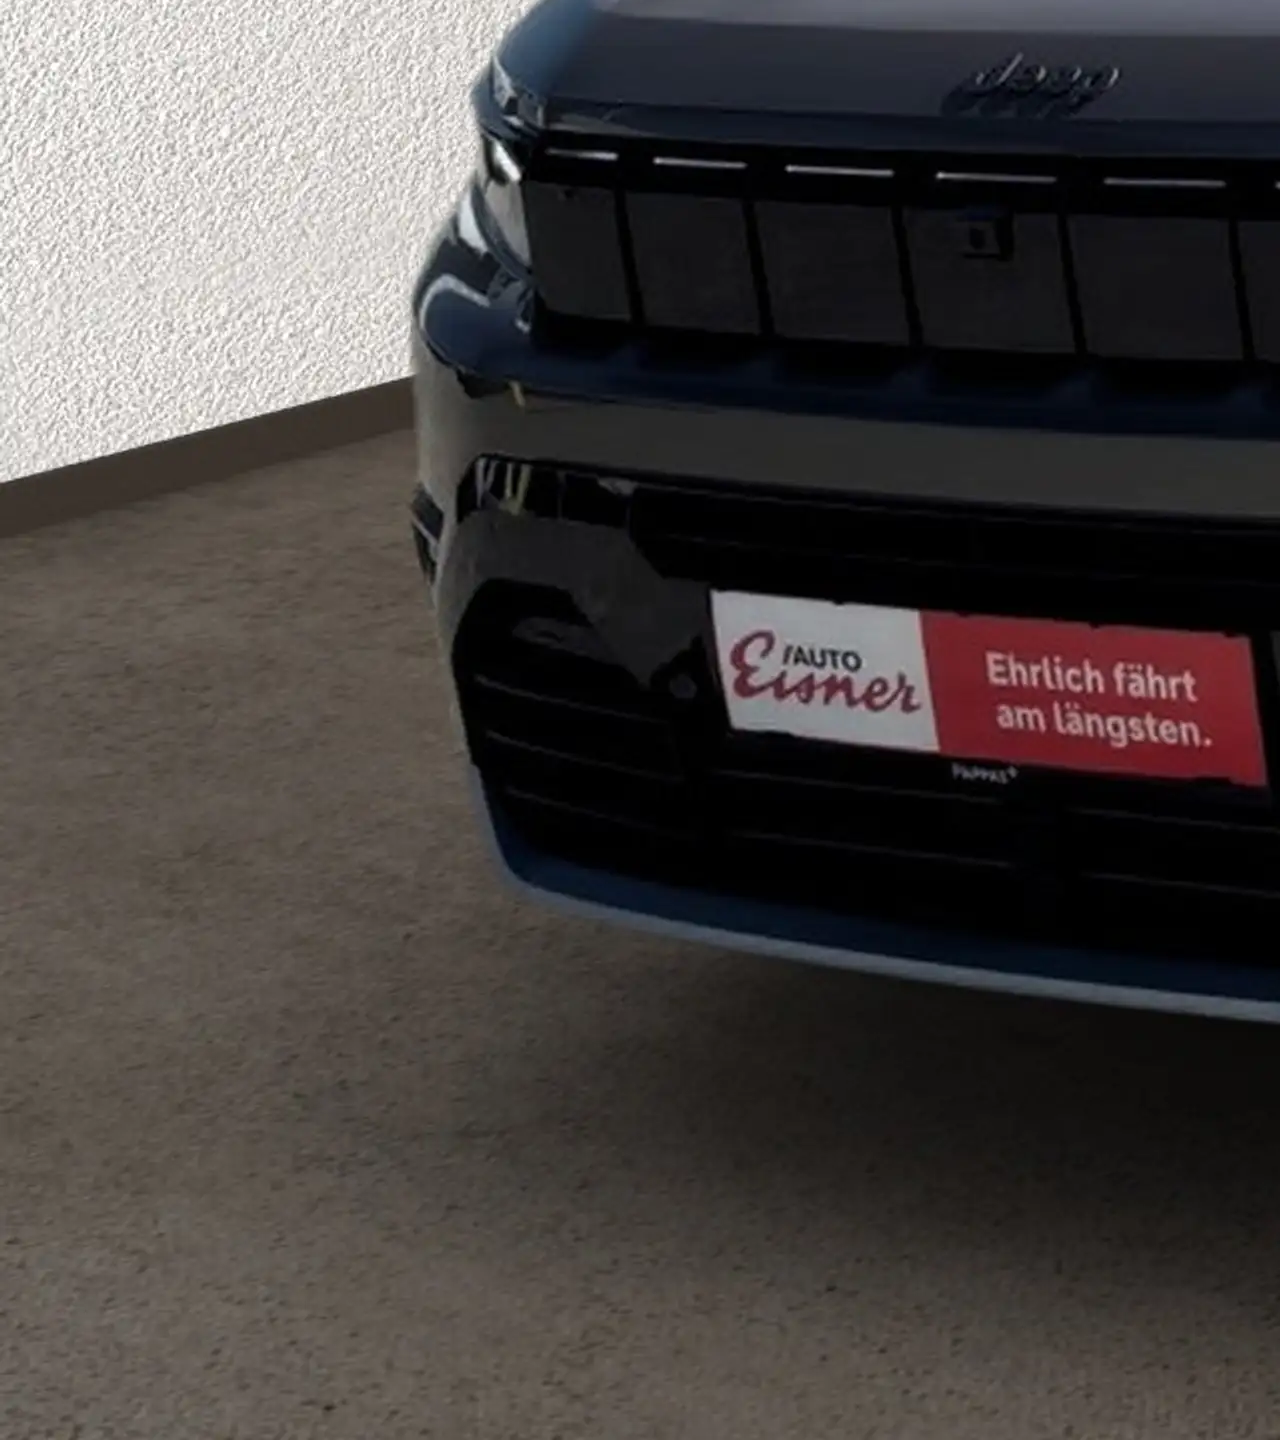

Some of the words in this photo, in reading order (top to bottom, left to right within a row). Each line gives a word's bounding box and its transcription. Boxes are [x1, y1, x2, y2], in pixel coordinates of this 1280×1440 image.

[730, 629, 922, 714] Eisner
[793, 645, 863, 673] AUTO
[985, 651, 1106, 694] Ehrlich
[1113, 661, 1199, 702] fährt
[996, 704, 1047, 733] am
[1052, 700, 1213, 748] längsten.
